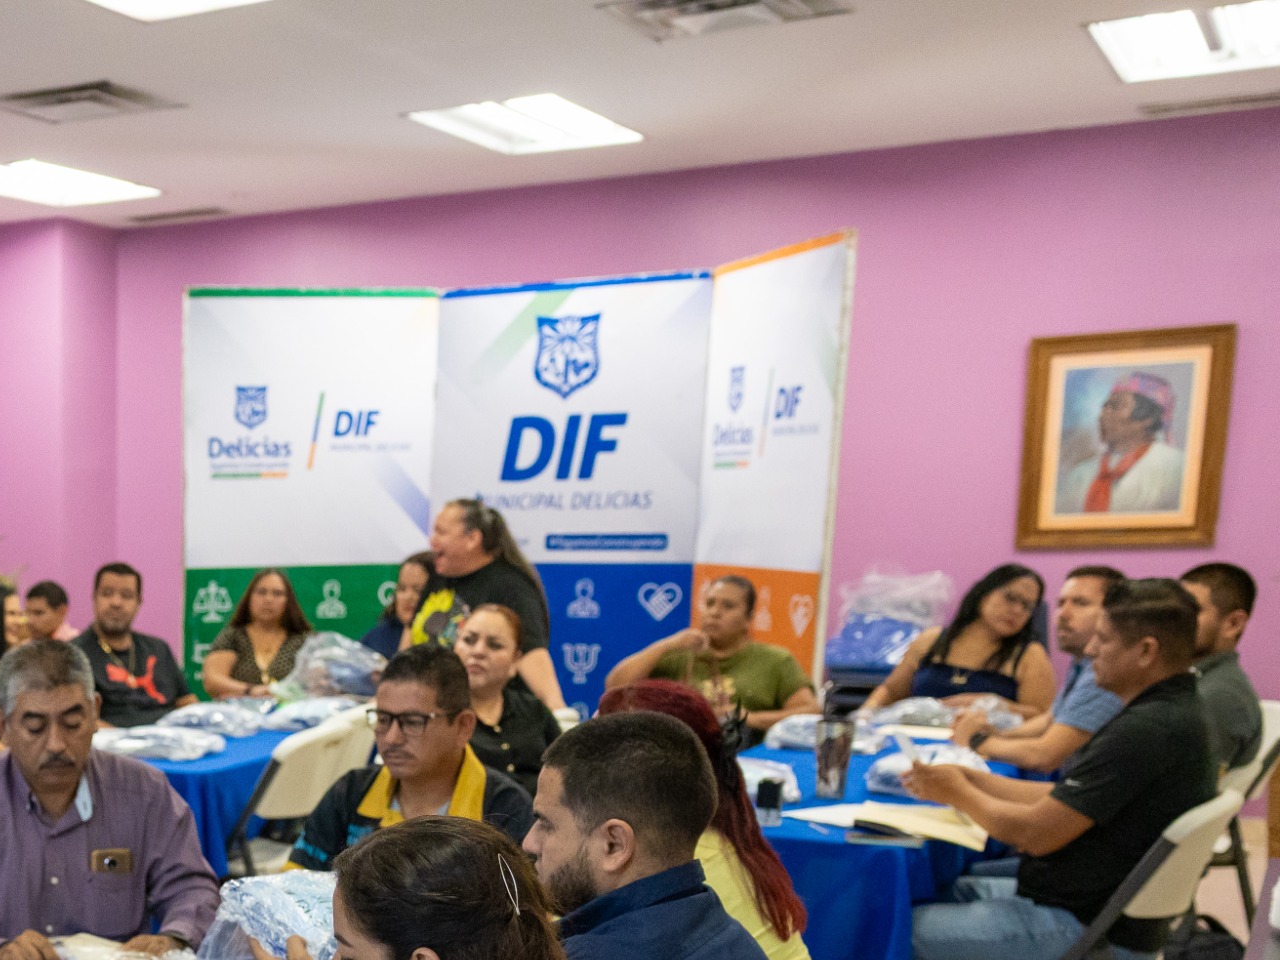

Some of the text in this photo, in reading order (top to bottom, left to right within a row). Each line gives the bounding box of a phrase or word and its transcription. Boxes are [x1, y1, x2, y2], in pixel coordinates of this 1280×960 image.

[333, 410, 379, 437] DIF
[208, 436, 291, 459] Delicias
[500, 413, 627, 482] DIF
[570, 490, 652, 511] DELICIAS
